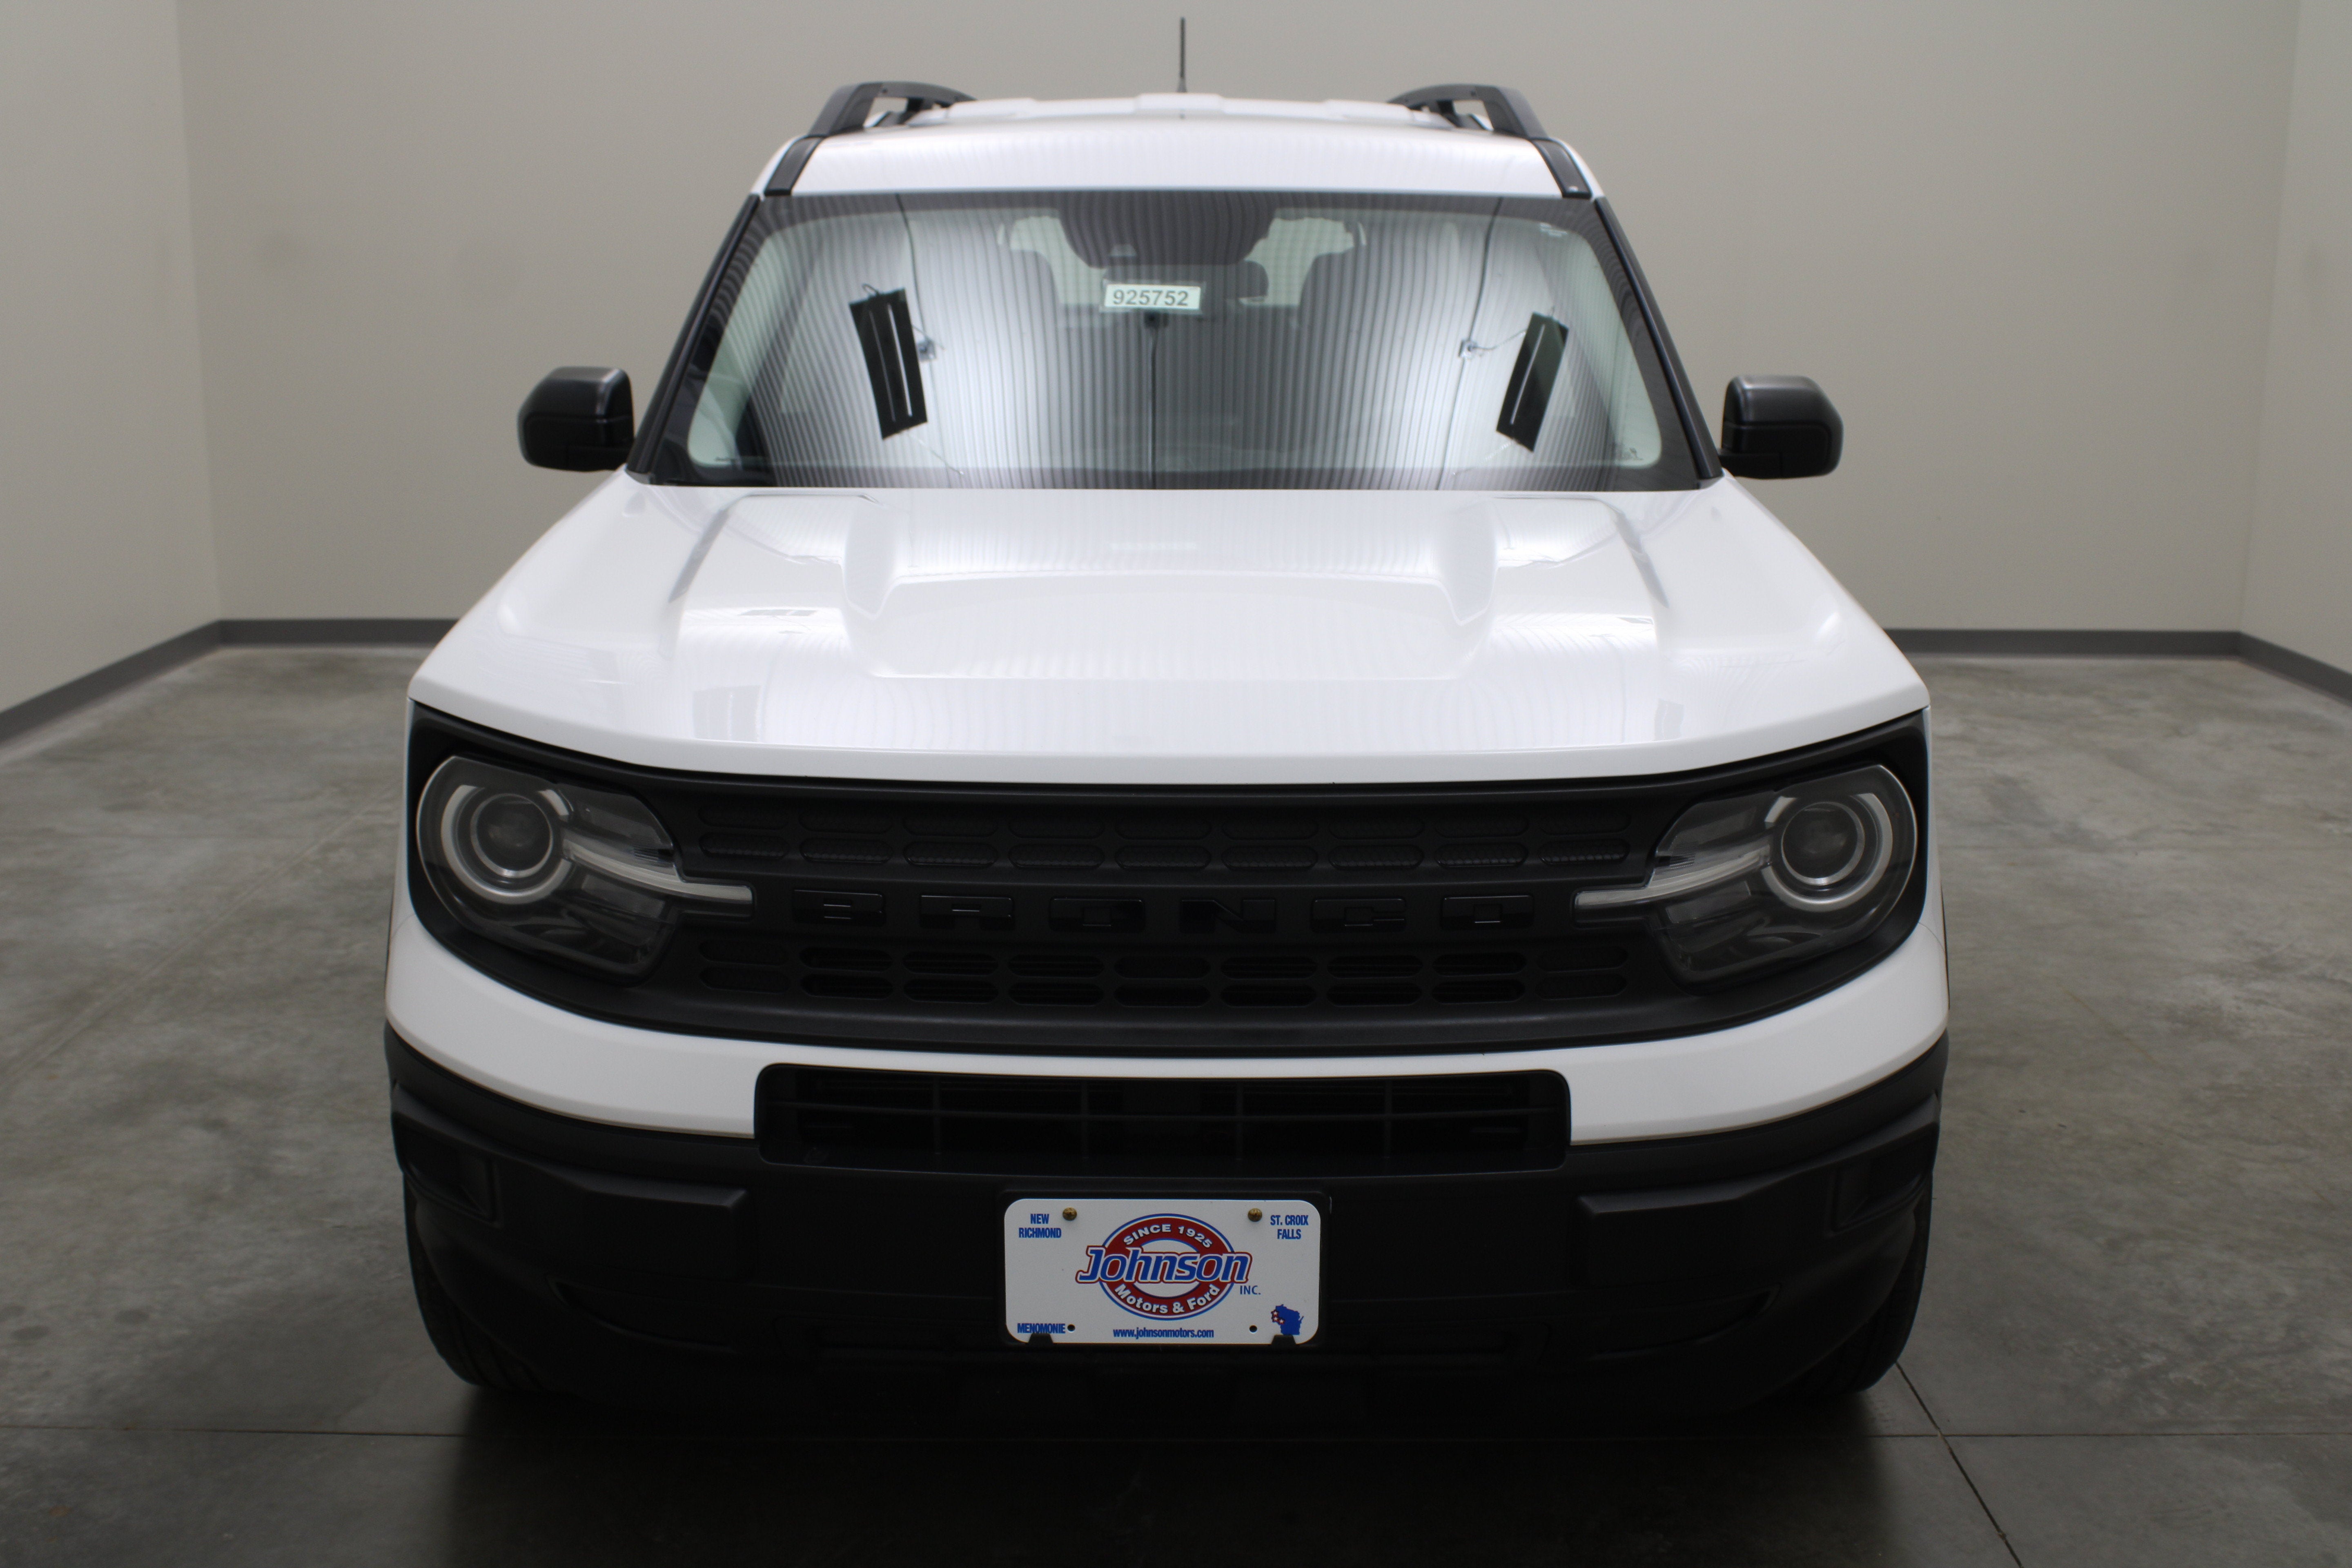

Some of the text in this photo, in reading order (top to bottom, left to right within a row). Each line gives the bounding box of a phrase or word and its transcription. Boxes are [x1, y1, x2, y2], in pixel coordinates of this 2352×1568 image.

[1112, 289, 1189, 306] 925752
[793, 889, 1535, 934] BRONCO
[1031, 1214, 1049, 1224] NEW
[1270, 1215, 1309, 1225] ST. CROIX
[1019, 1227, 1062, 1238] RICHMOND
[1123, 1224, 1213, 1249] SINCE 1925
[1277, 1229, 1301, 1239] FALLS
[1077, 1247, 1250, 1283] Johnson
[1240, 1285, 1261, 1295] INC.
[1114, 1283, 1221, 1314] Motors & Ford
[1017, 1323, 1066, 1334] MENOMONIE
[1113, 1327, 1214, 1340] www.johnsonmotors.com
